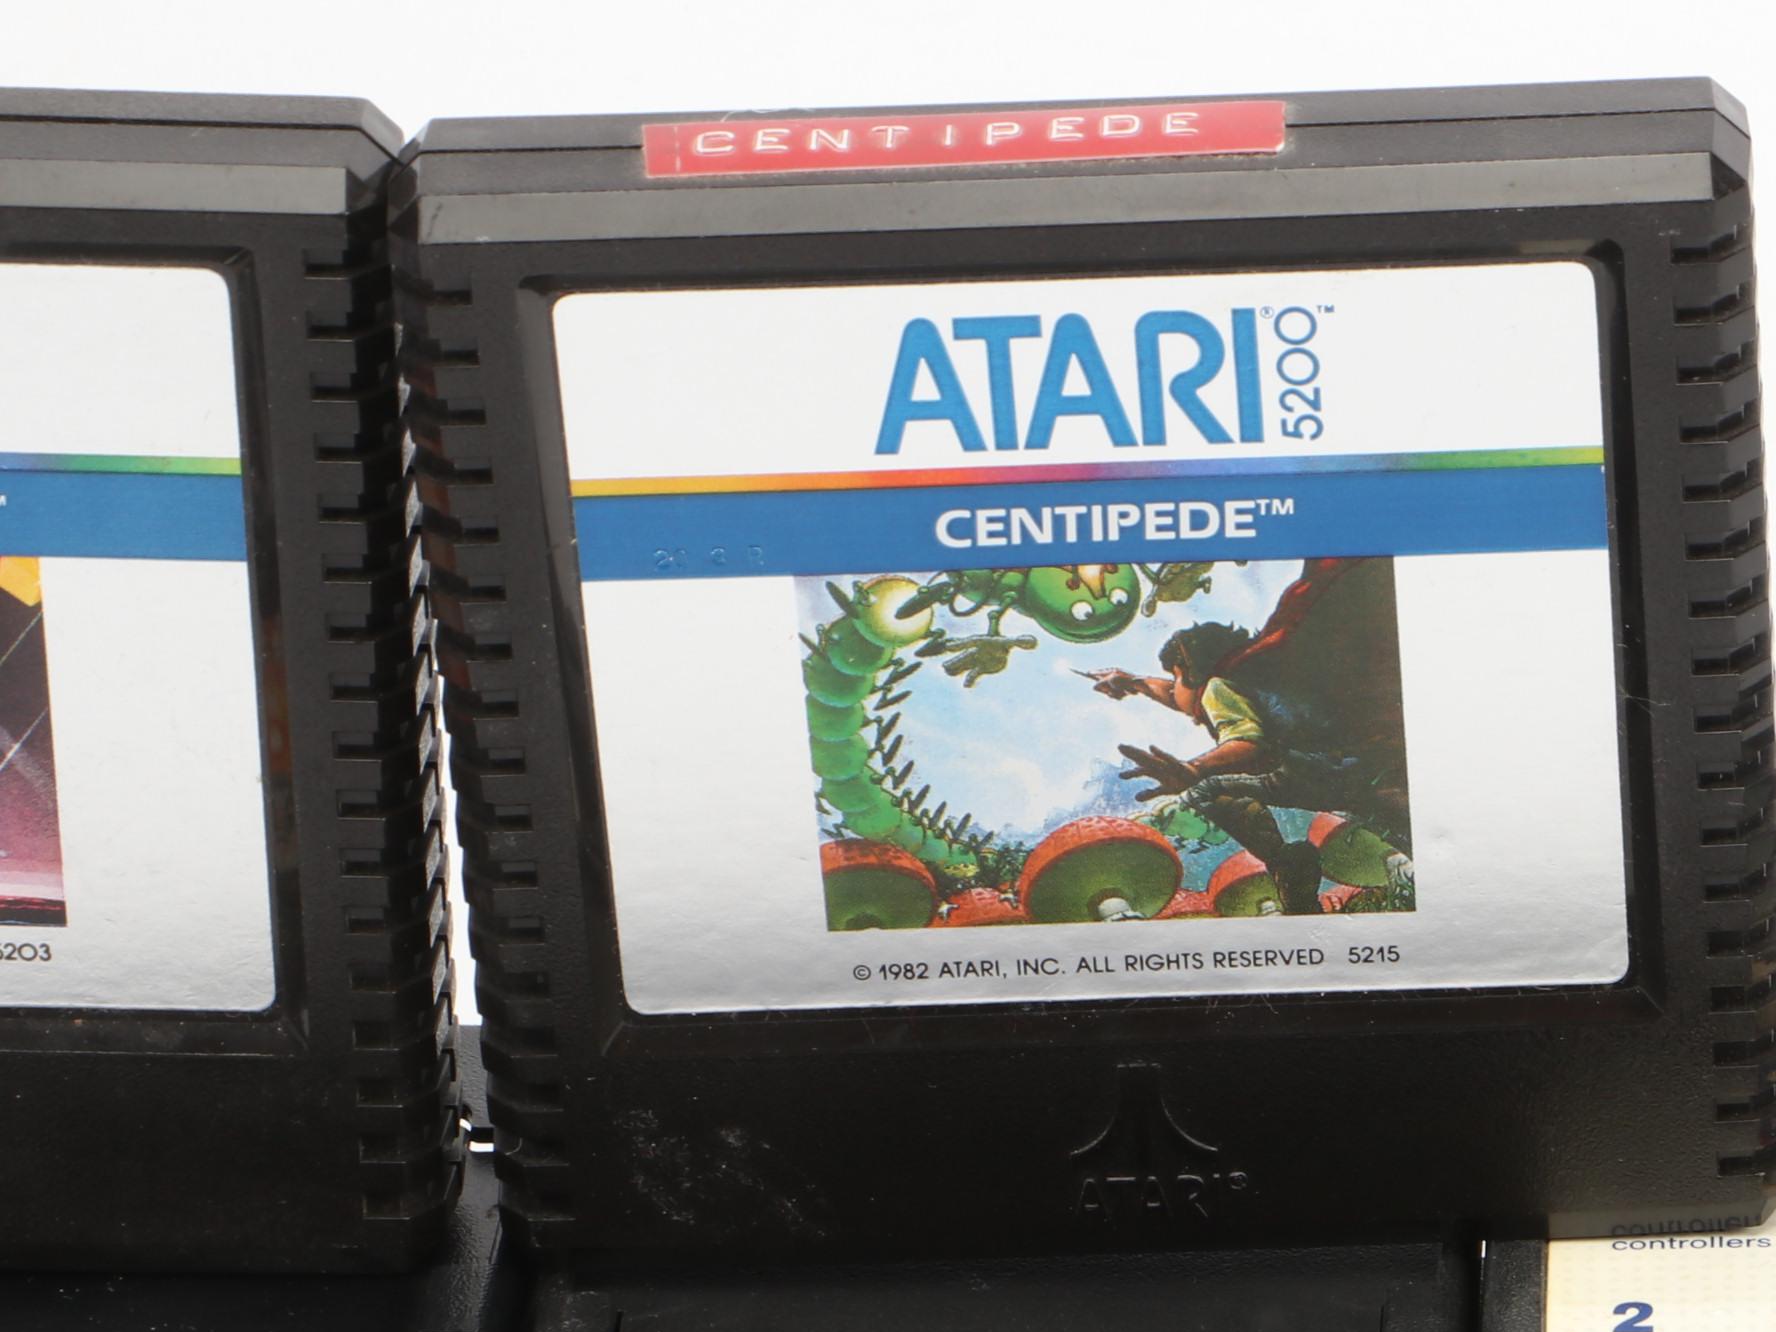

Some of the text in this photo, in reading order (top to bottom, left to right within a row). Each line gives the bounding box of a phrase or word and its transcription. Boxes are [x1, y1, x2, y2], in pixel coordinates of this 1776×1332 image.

[696, 111, 1200, 154] CENTIPEDE
[878, 962, 930, 981] 1982
[938, 959, 1008, 980] ATARI,
[1016, 957, 1067, 977] INC.
[1075, 955, 1116, 975] ALL
[1124, 951, 1205, 973] RIGHTS
[1212, 948, 1325, 970] RESERVED
[1347, 945, 1401, 965] 5215
[1611, 1235, 1772, 1251] controllers
